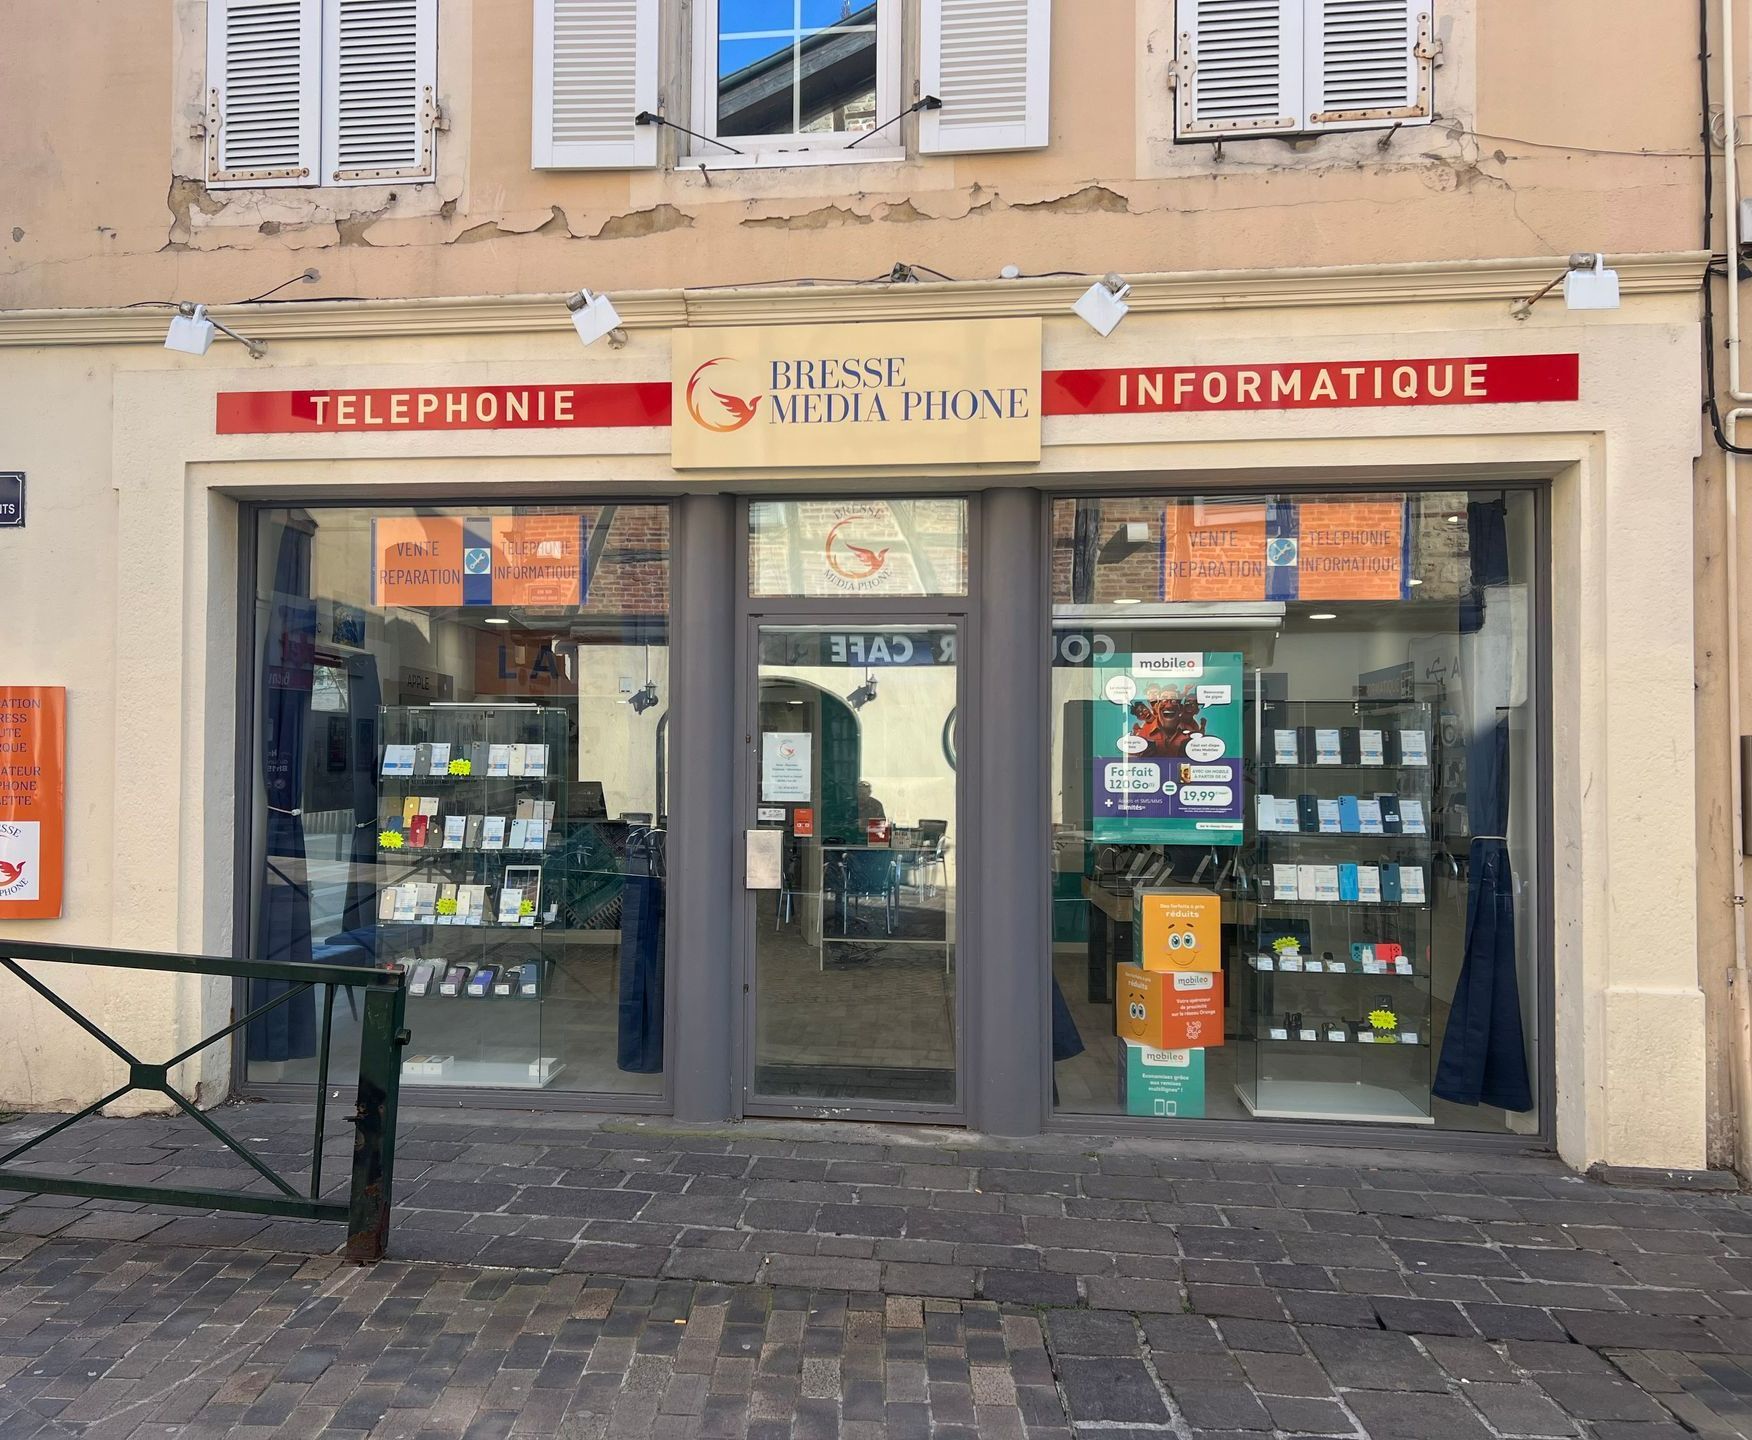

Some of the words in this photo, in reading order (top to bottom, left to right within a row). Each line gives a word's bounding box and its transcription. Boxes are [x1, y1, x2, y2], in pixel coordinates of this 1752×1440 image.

[769, 357, 906, 390] BRESSE
[1119, 363, 1488, 407] INFORMATIQUE
[310, 390, 575, 426] TELEPHONIE
[769, 391, 890, 424] MEDIA
[901, 388, 1030, 422] PHONE
[0, 503, 15, 515] TS
[1189, 530, 1238, 548] VENTE
[1308, 530, 1392, 546] TELEPHONIE
[397, 541, 439, 557] VENTE
[501, 540, 572, 556] TELEPHONIE
[494, 565, 578, 580] INFORMATIQUE
[1169, 560, 1262, 578] REPARATION
[1300, 556, 1399, 573] INFORMATIQUE
[379, 568, 460, 585] REPARATION
[823, 569, 855, 591] MEDIA
[857, 567, 894, 591] PHONE
[1139, 657, 1195, 670] mobileo
[407, 674, 431, 691] APPLE
[0, 698, 41, 709] ATION
[0, 742, 27, 753] QUE
[1, 766, 41, 776] ATEUR
[0, 795, 32, 806] ETTE
[1183, 791, 1215, 802] 19,99
[0, 823, 22, 838] SSE
[1166, 910, 1200, 918] réduits
[1178, 976, 1208, 985] mobileo
[1147, 1052, 1184, 1061] mobileo
